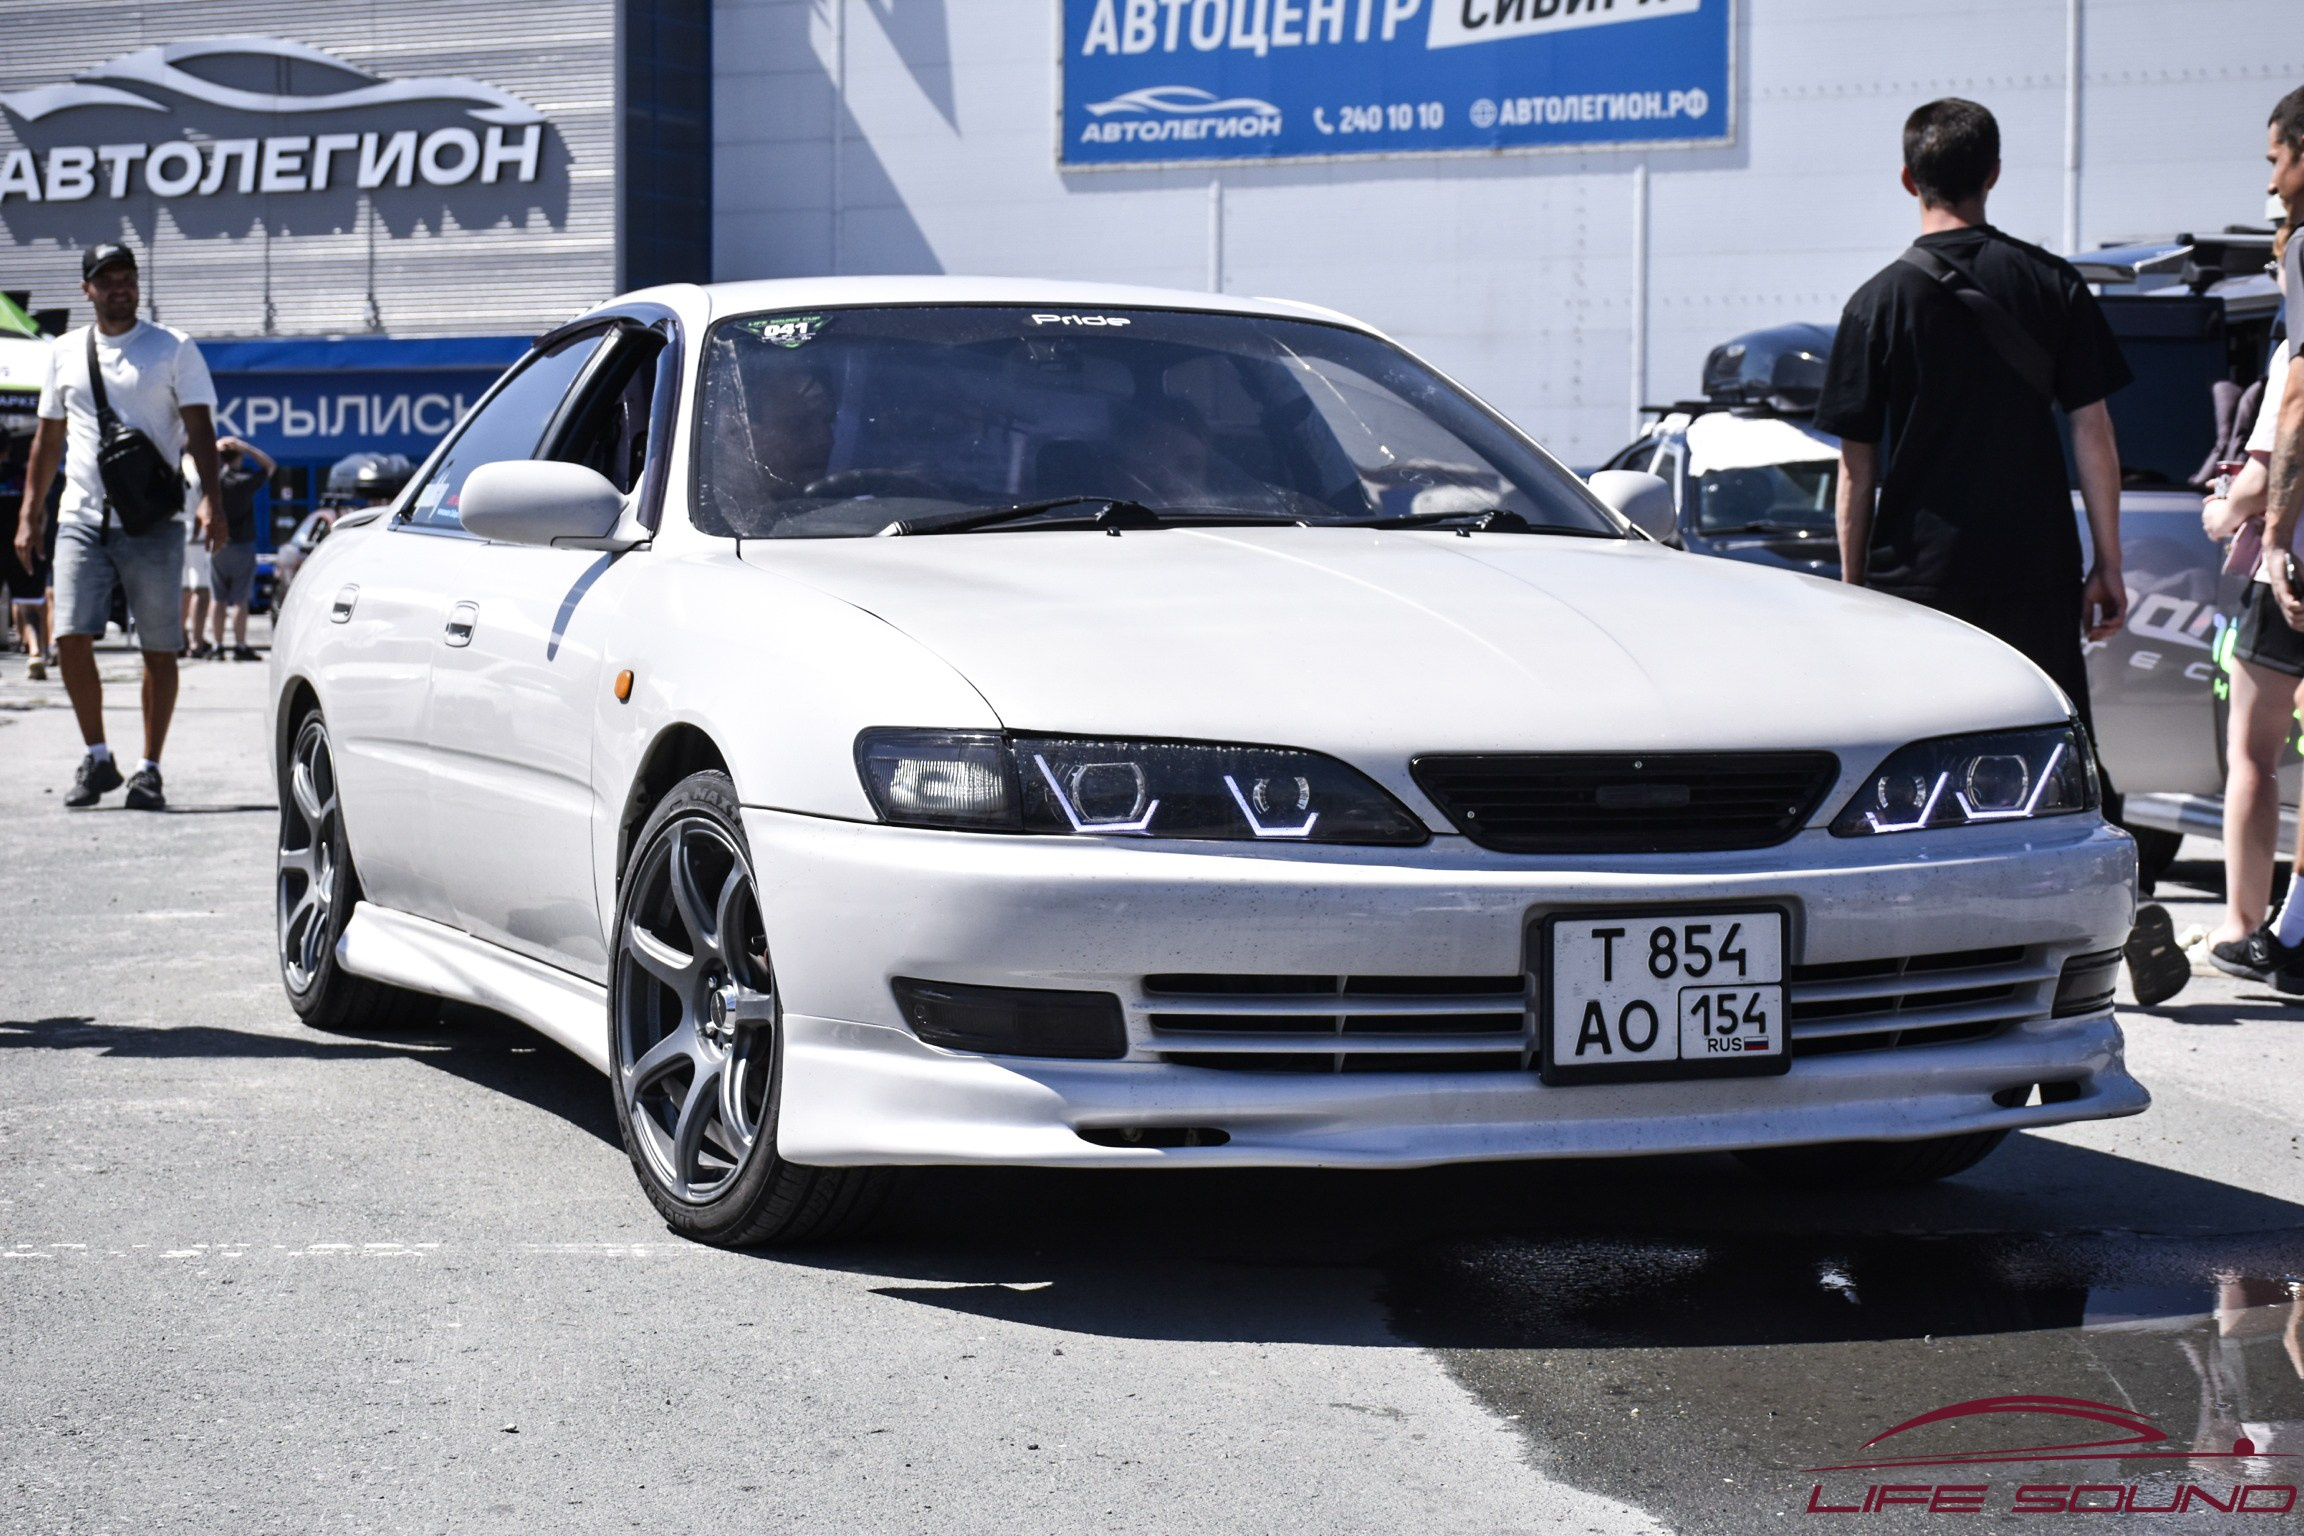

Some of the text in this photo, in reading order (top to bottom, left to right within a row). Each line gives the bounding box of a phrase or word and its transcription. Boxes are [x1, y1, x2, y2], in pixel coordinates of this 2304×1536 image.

[1081, 0, 1422, 57] АВТОЦЕНТР
[1339, 101, 1444, 133] 240 10 10
[1499, 87, 1709, 126] АВТОЛЕГИОН.РФ
[1080, 114, 1283, 143] АВТОЛЕГИОН
[0, 125, 543, 202] АВТОЛЕГИОН
[763, 321, 809, 337] 041
[1030, 314, 1132, 327] Pride
[1591, 922, 1747, 982] Т 854
[1574, 999, 1660, 1057] АО
[1690, 991, 1767, 1037] 154
[1707, 1036, 1743, 1053] RUS
